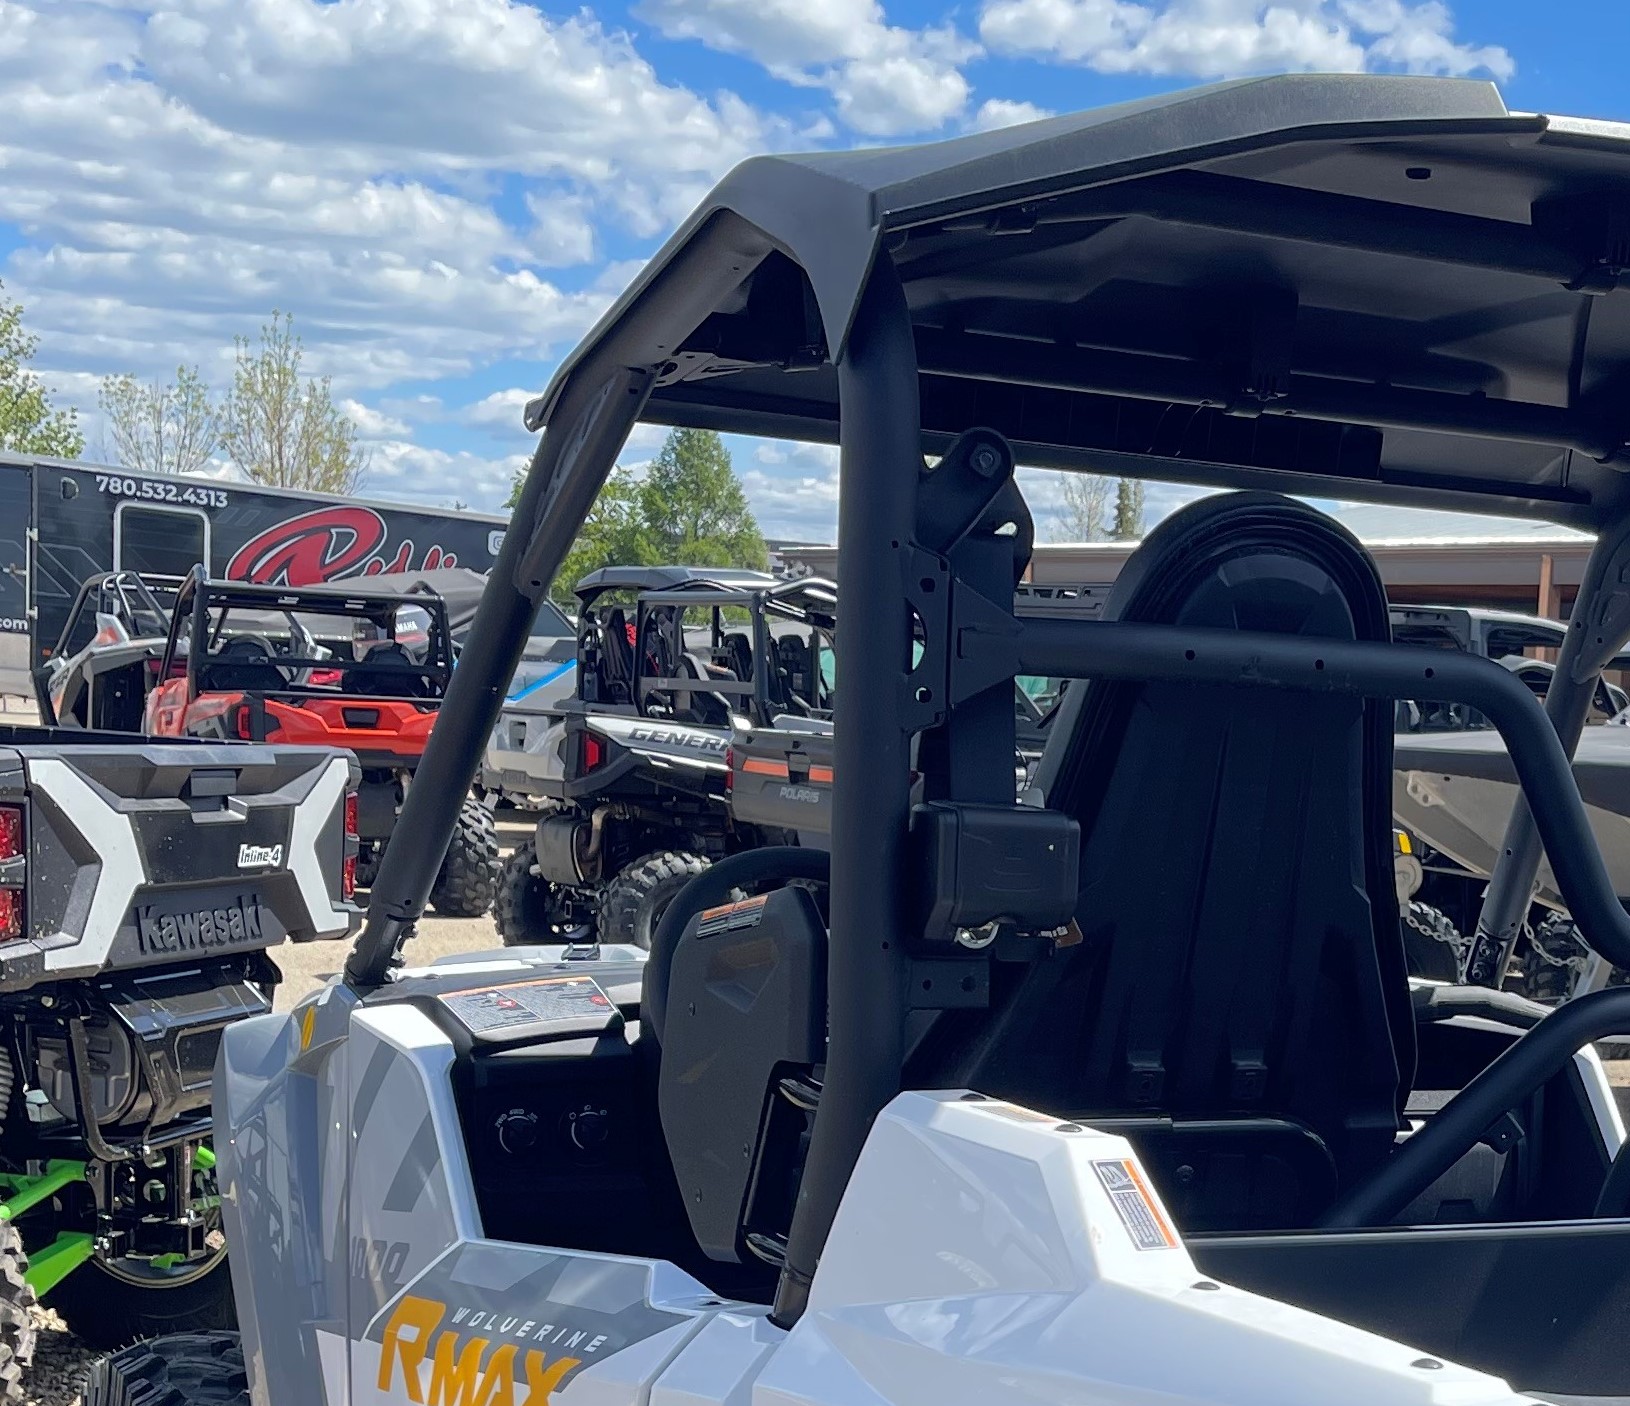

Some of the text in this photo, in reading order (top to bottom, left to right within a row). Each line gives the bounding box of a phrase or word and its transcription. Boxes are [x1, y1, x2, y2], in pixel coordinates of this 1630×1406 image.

[95, 475, 228, 508] 780.532.4313
[0, 617, 28, 631] om
[780, 787, 820, 803] POLARIS
[240, 845, 281, 867] Inline-4
[136, 894, 264, 955] Kawasaki
[452, 1306, 608, 1354] WOLVERINE
